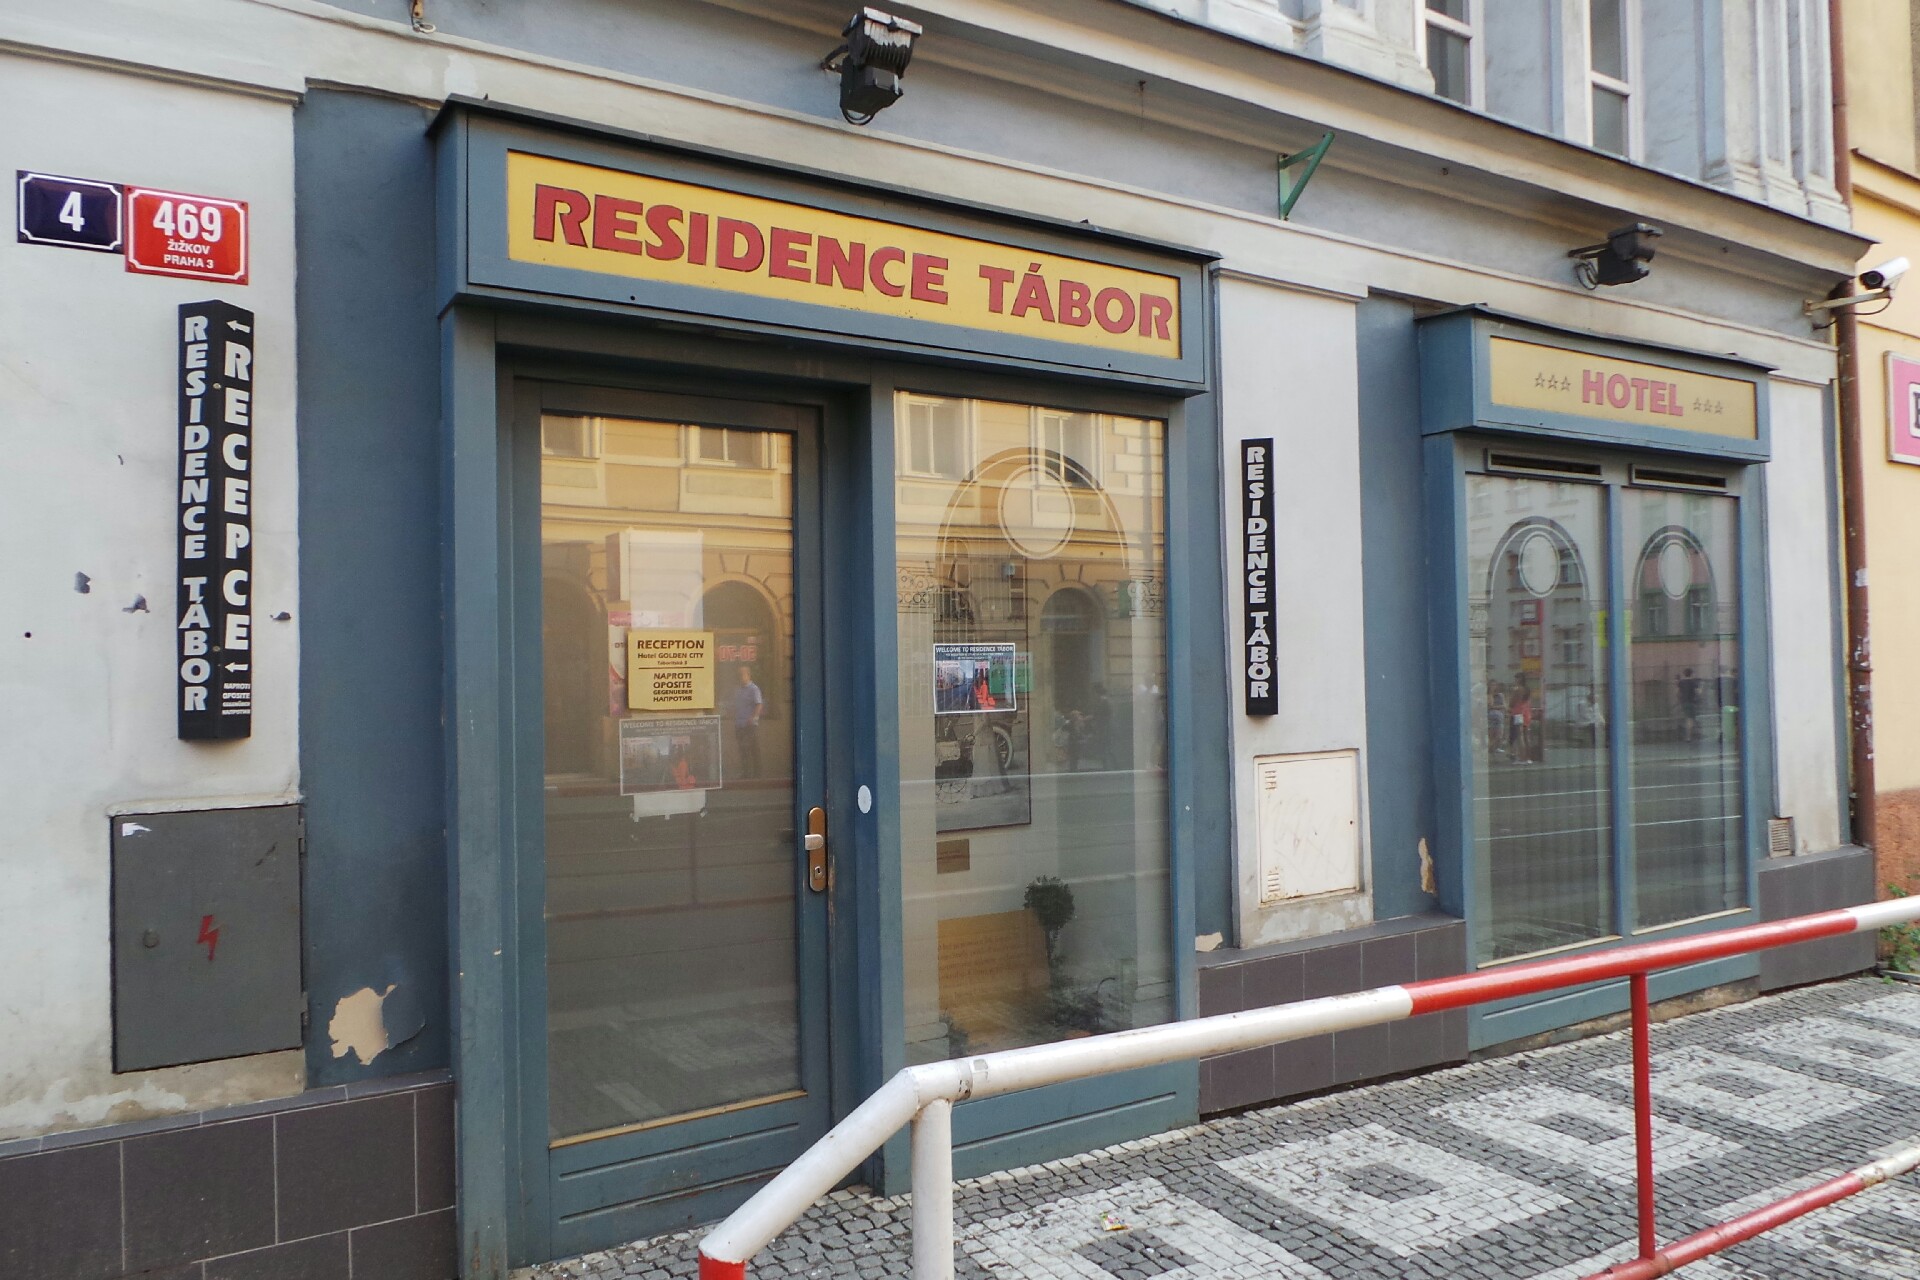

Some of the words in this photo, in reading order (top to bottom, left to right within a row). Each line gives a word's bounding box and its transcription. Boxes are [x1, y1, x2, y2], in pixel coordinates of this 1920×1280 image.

[59, 191, 86, 232] 4
[153, 200, 222, 243] 469
[163, 253, 205, 268] PRAHA
[206, 258, 214, 269] 3
[166, 238, 211, 255] ŽIŽKOV
[533, 183, 949, 305] RESIDENCE
[978, 262, 1173, 341] TÁBOR
[1582, 369, 1684, 417] HOTEL
[181, 315, 210, 560] RESIDENCE
[222, 340, 252, 650] RECEPCE
[1247, 446, 1268, 604] RESIDENCE
[178, 576, 211, 711] TÁBOR
[637, 639, 705, 649] RECEPTION
[1246, 611, 1271, 698] TÁBOR
[653, 672, 692, 680] NAPROTI
[653, 681, 692, 689] OPOSITE
